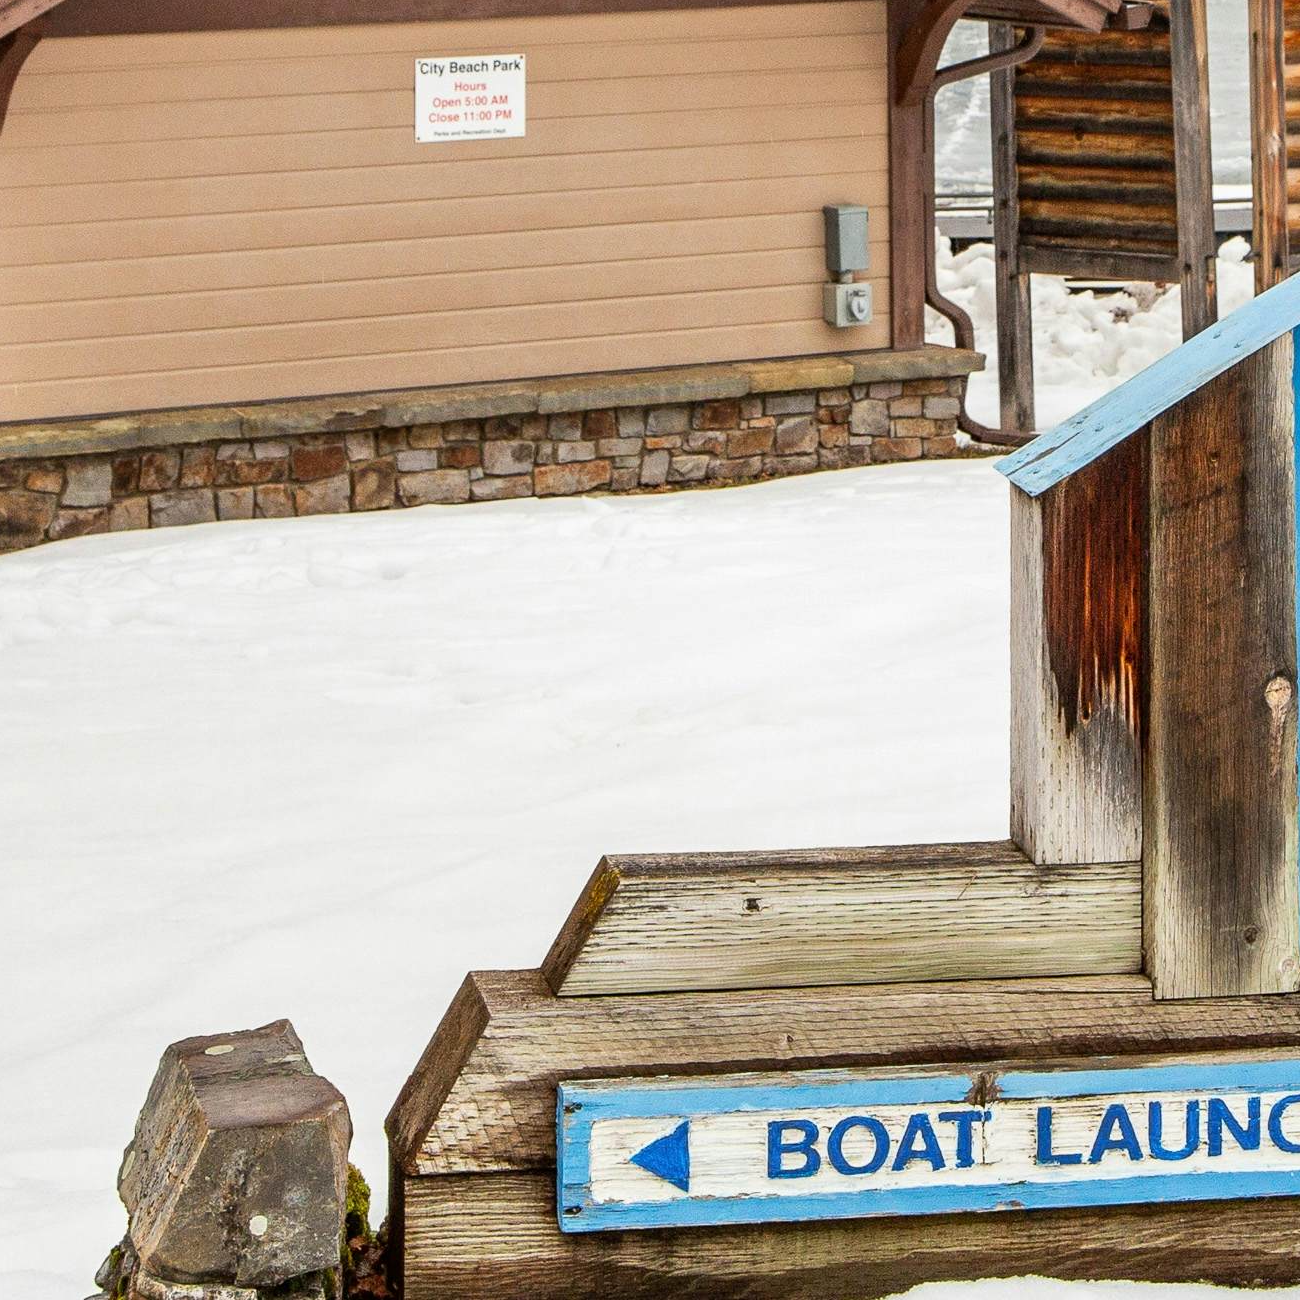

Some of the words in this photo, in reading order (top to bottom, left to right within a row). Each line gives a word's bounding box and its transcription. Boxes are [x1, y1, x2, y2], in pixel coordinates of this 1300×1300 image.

[420, 62, 445, 76] City
[449, 61, 489, 74] Beach
[493, 59, 521, 72] Park
[454, 81, 487, 93] Hours
[432, 97, 461, 109] Open
[465, 95, 488, 107] 5:00
[491, 95, 509, 105] AM
[428, 112, 460, 123] Close
[463, 111, 492, 121] 11:00
[495, 109, 512, 120] PM
[766, 1109, 991, 1181] BOAT
